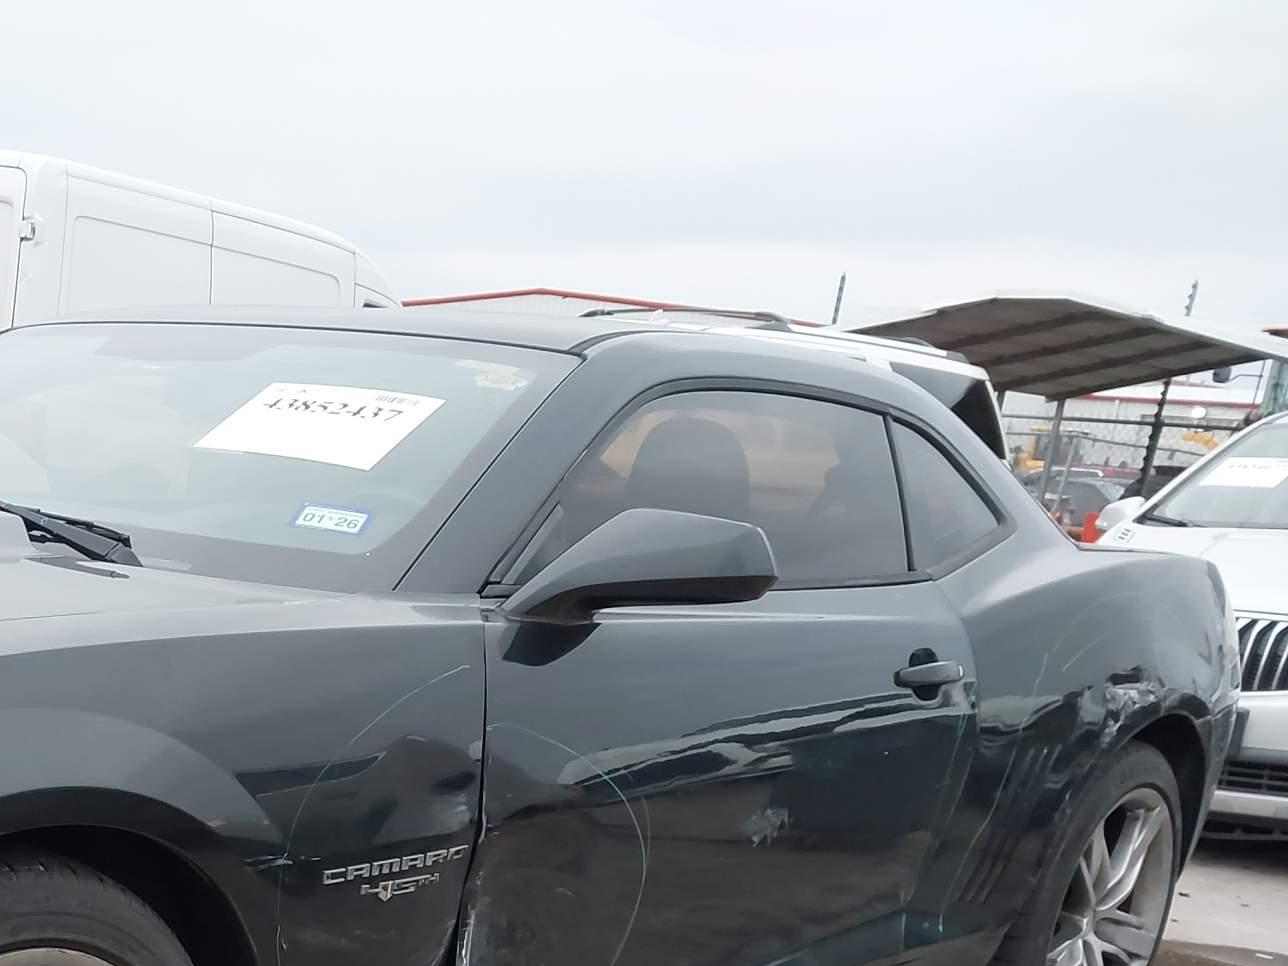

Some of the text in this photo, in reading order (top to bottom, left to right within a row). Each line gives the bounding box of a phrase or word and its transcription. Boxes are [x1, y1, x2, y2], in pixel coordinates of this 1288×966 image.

[263, 398, 405, 422] 43852437
[302, 512, 326, 524] 01
[334, 516, 361, 529] 26
[322, 844, 469, 885] CAMARO
